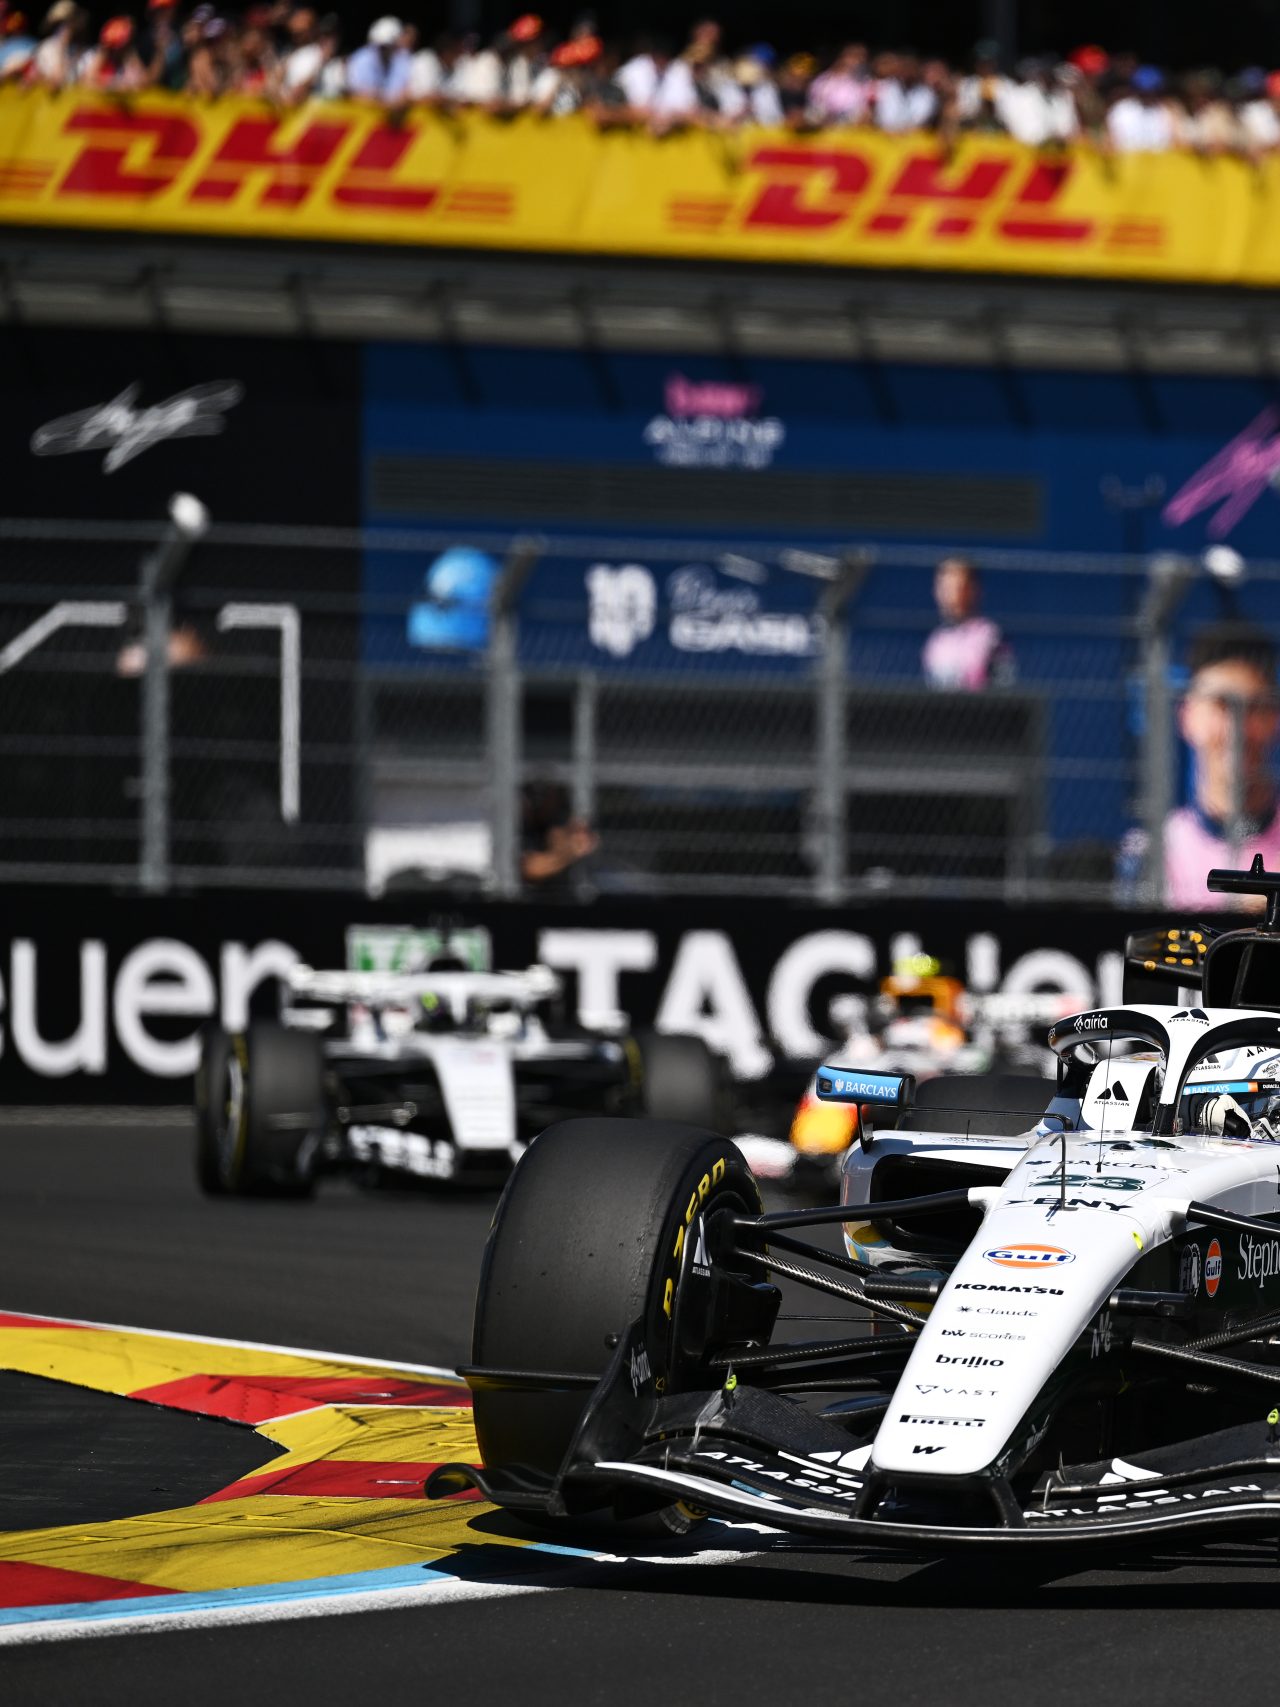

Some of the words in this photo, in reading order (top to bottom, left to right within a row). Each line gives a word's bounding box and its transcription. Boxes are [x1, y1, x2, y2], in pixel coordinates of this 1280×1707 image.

[57, 107, 440, 213] DHL
[743, 146, 1094, 242] DHL
[0, 938, 305, 1076] uer
[1084, 1014, 1109, 1030] airia
[845, 1081, 897, 1098] BARCLAYS
[1192, 1084, 1230, 1092] BARCLAYS
[1058, 1160, 1190, 1174] BARCLAYS
[1028, 1174, 1147, 1191] 23
[987, 1250, 1072, 1262] Gulf
[1206, 1259, 1221, 1277] Gulf
[954, 1283, 1065, 1296] KOMATSU
[976, 1307, 1039, 1317] Claude
[969, 1332, 1026, 1340] SCORES
[935, 1354, 1005, 1368] brillio
[943, 1388, 999, 1396] VAST
[899, 1414, 986, 1427] PIRELLI
[695, 1451, 856, 1501] ATLASSI
[1022, 1484, 1262, 1519] ATLASSIAN
